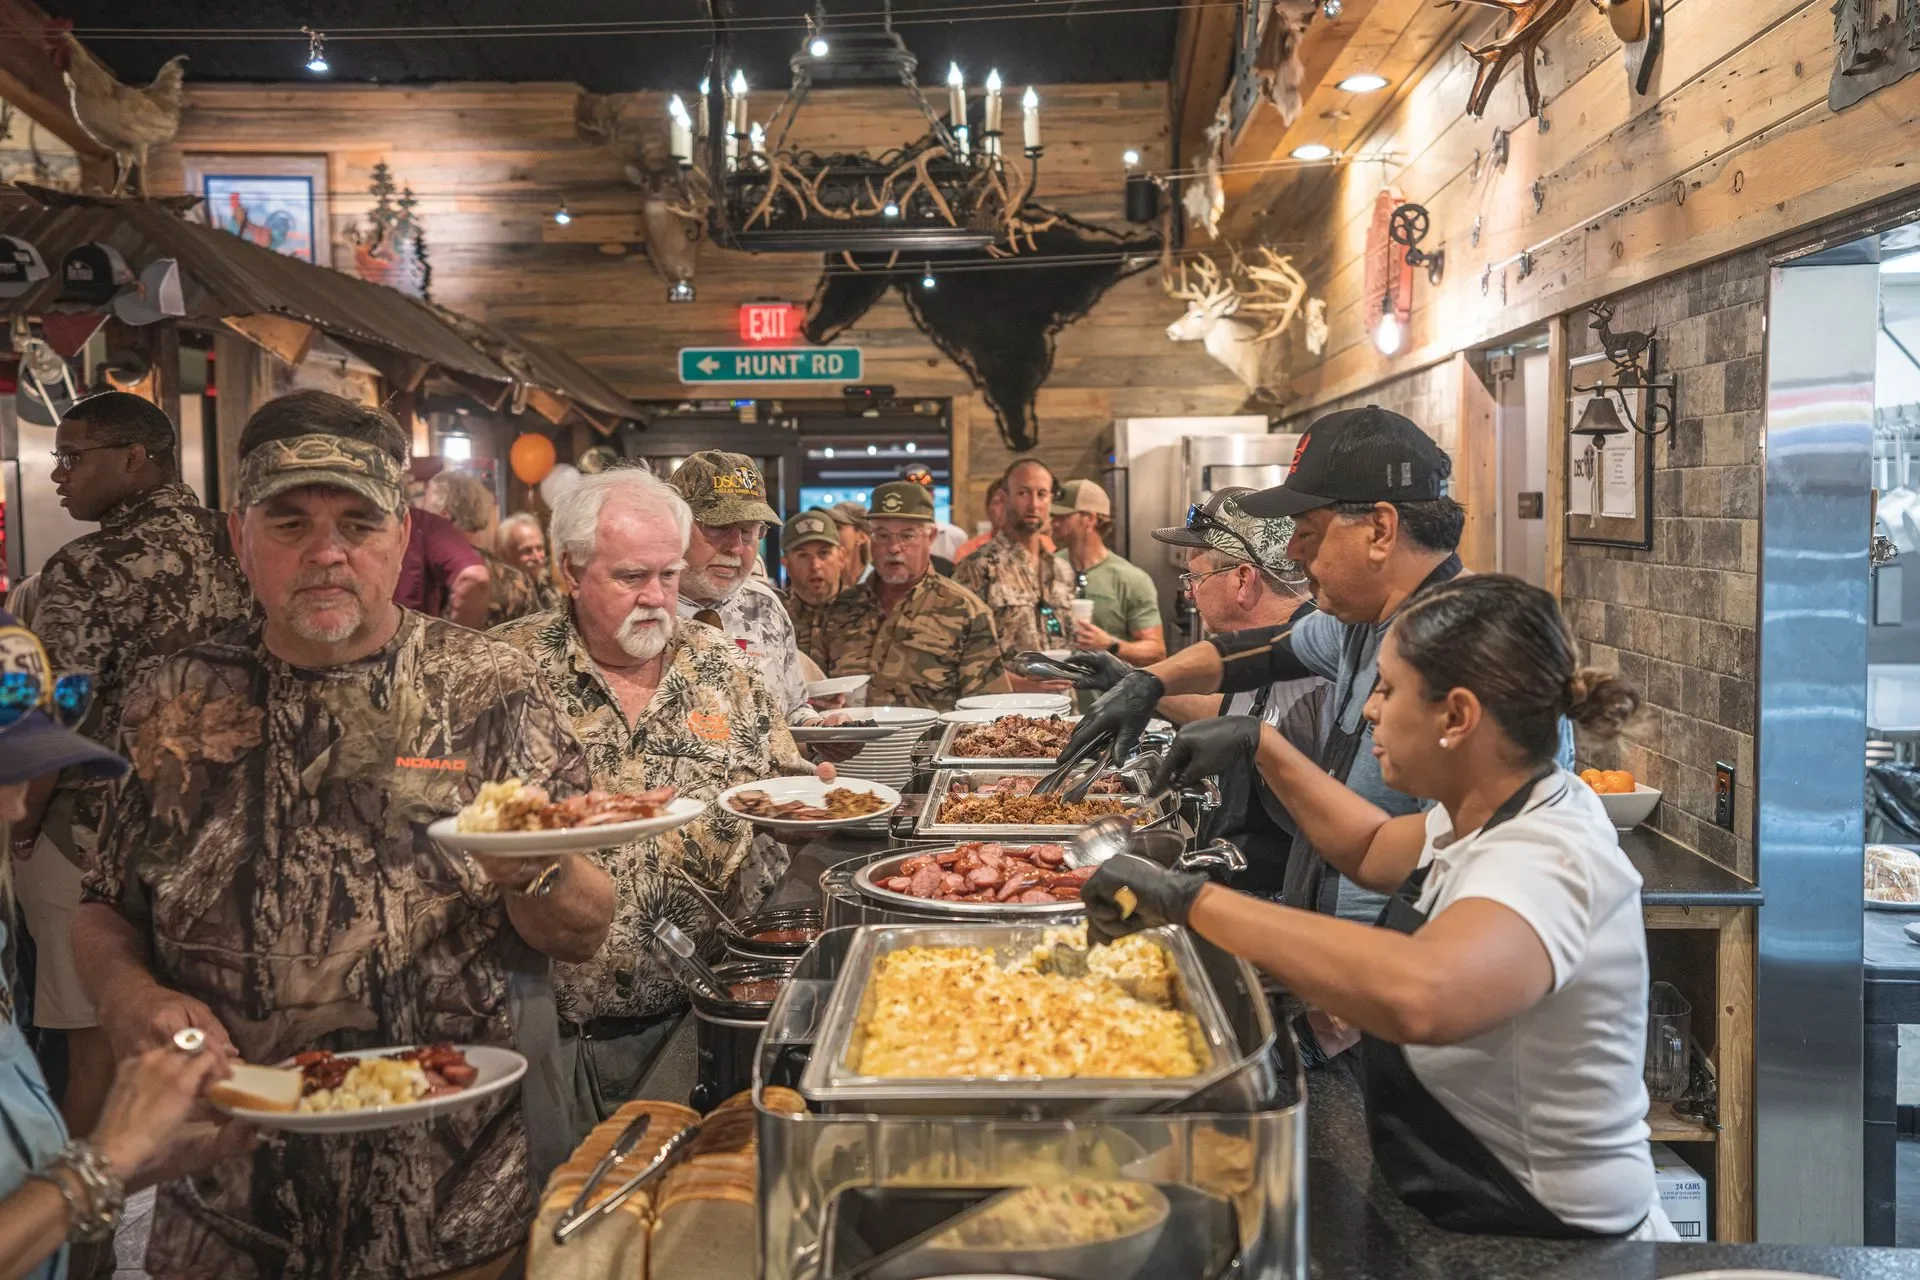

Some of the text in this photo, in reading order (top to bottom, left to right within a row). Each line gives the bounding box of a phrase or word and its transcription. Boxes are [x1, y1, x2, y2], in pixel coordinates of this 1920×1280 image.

[749, 308, 788, 338] EXIT
[735, 354, 844, 375] HUNT RD
[712, 475, 741, 488] DSC
[395, 756, 468, 771] NOMAD
[1684, 1182, 1701, 1190] CANS
